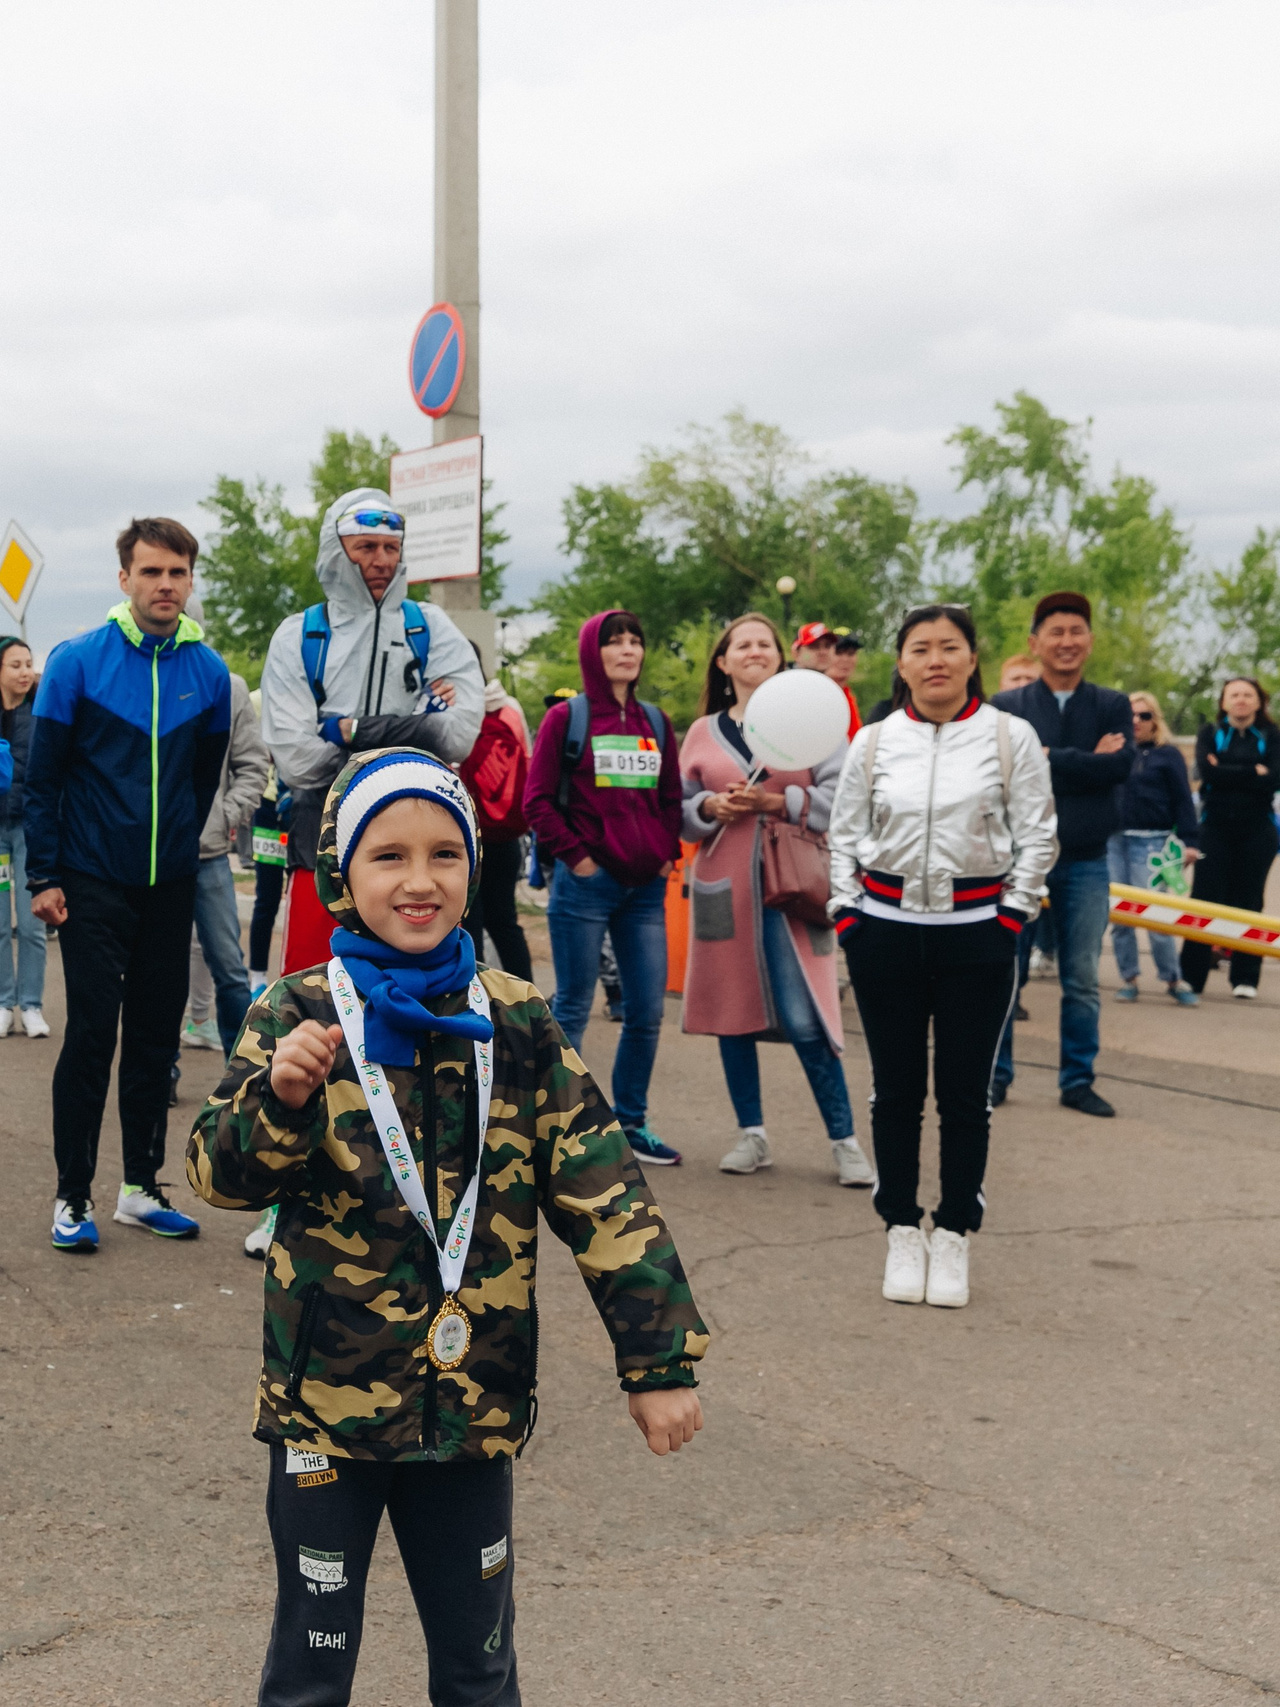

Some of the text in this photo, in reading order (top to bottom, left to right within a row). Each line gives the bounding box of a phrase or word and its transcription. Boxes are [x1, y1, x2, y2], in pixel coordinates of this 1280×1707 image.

[617, 755, 657, 771] 0158
[302, 1455, 325, 1468] THE
[297, 1470, 334, 1486] NATURE
[300, 1546, 327, 1560] NATIONAL
[308, 1629, 346, 1650] YEAH!
